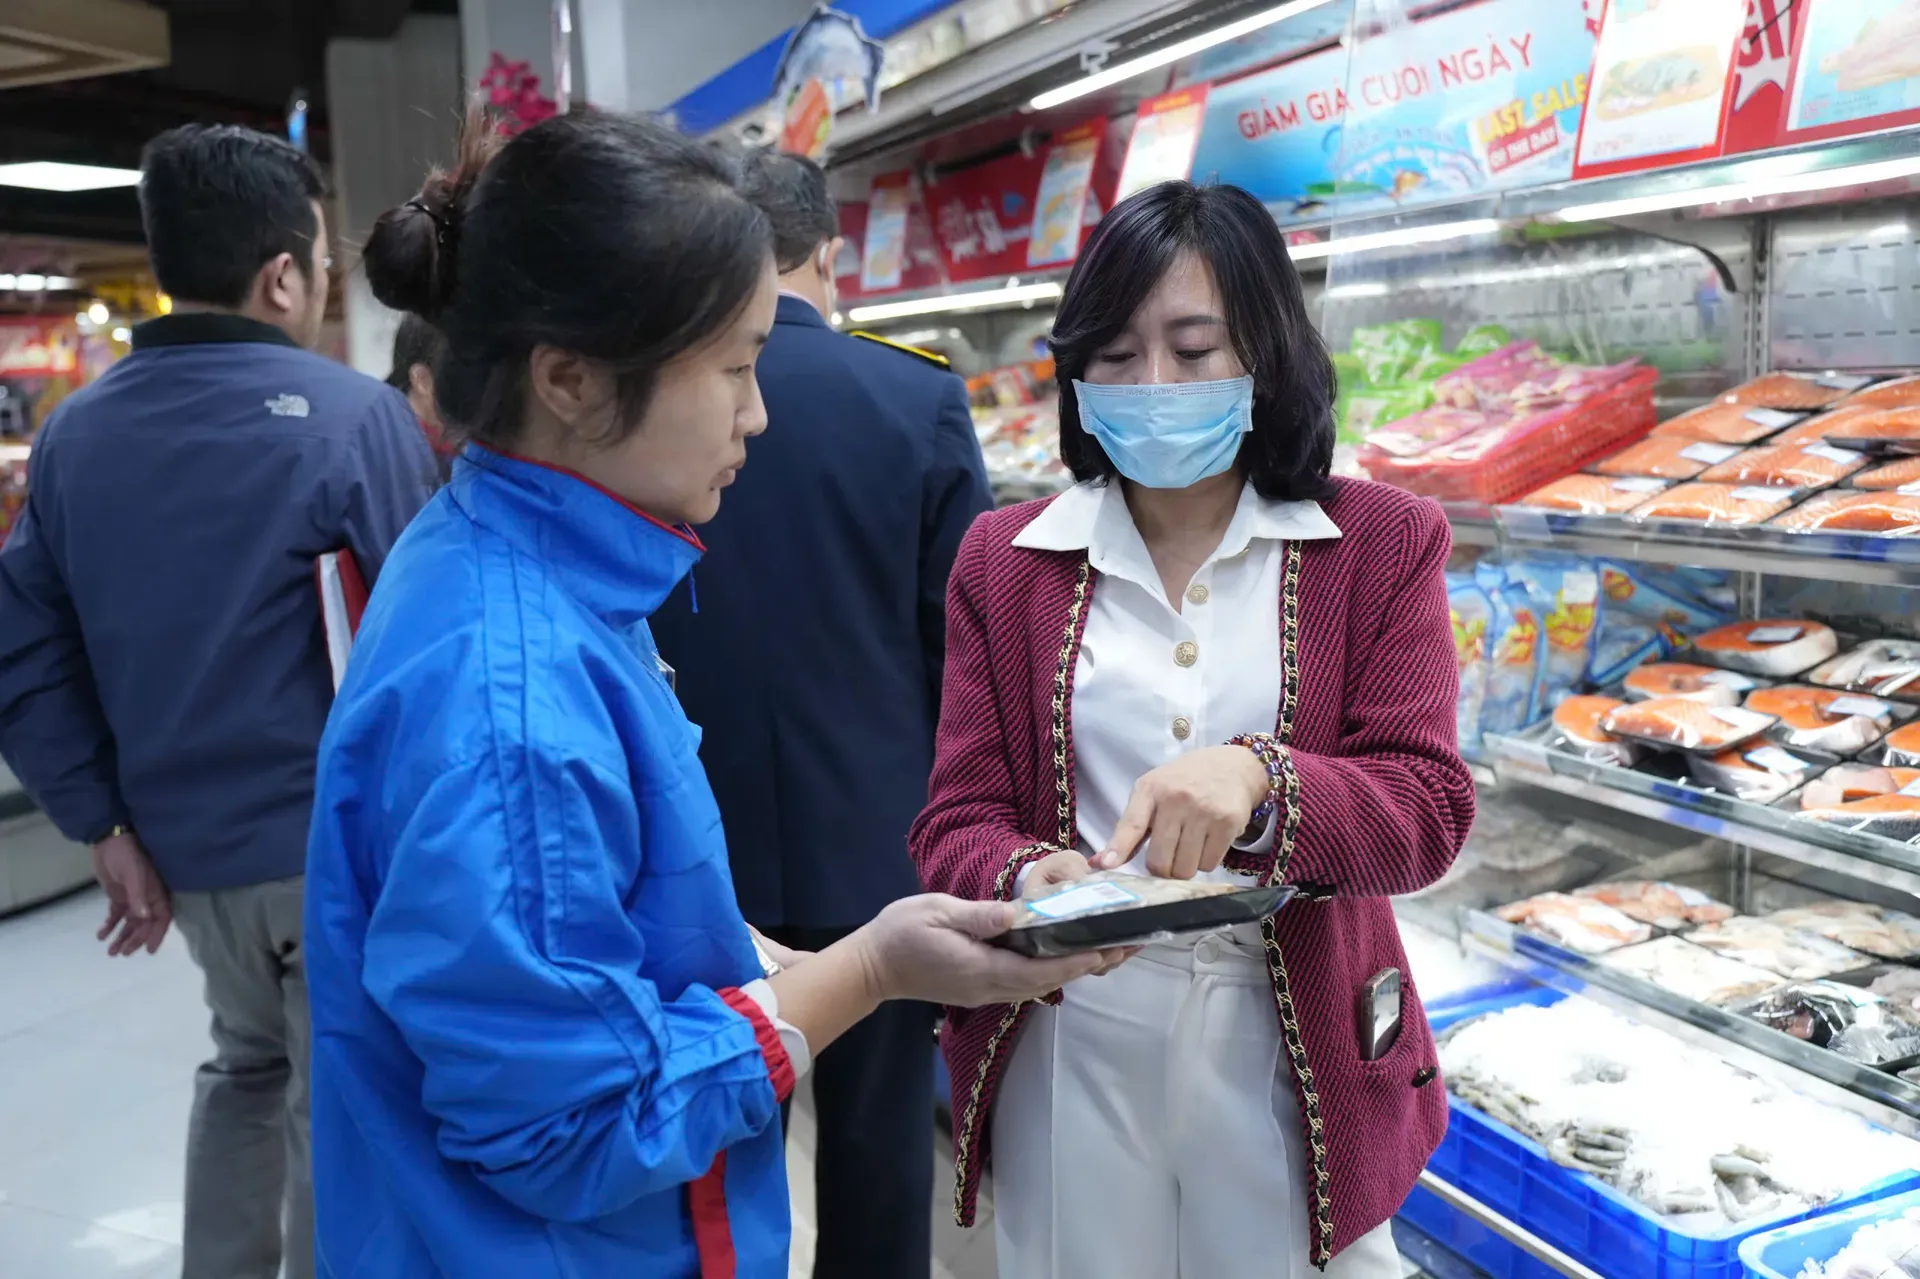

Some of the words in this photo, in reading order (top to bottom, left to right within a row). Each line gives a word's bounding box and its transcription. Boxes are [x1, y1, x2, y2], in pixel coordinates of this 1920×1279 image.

[1436, 33, 1533, 89] NGÀY
[1477, 98, 1526, 143] LAST
[1532, 72, 1588, 121] SALE
